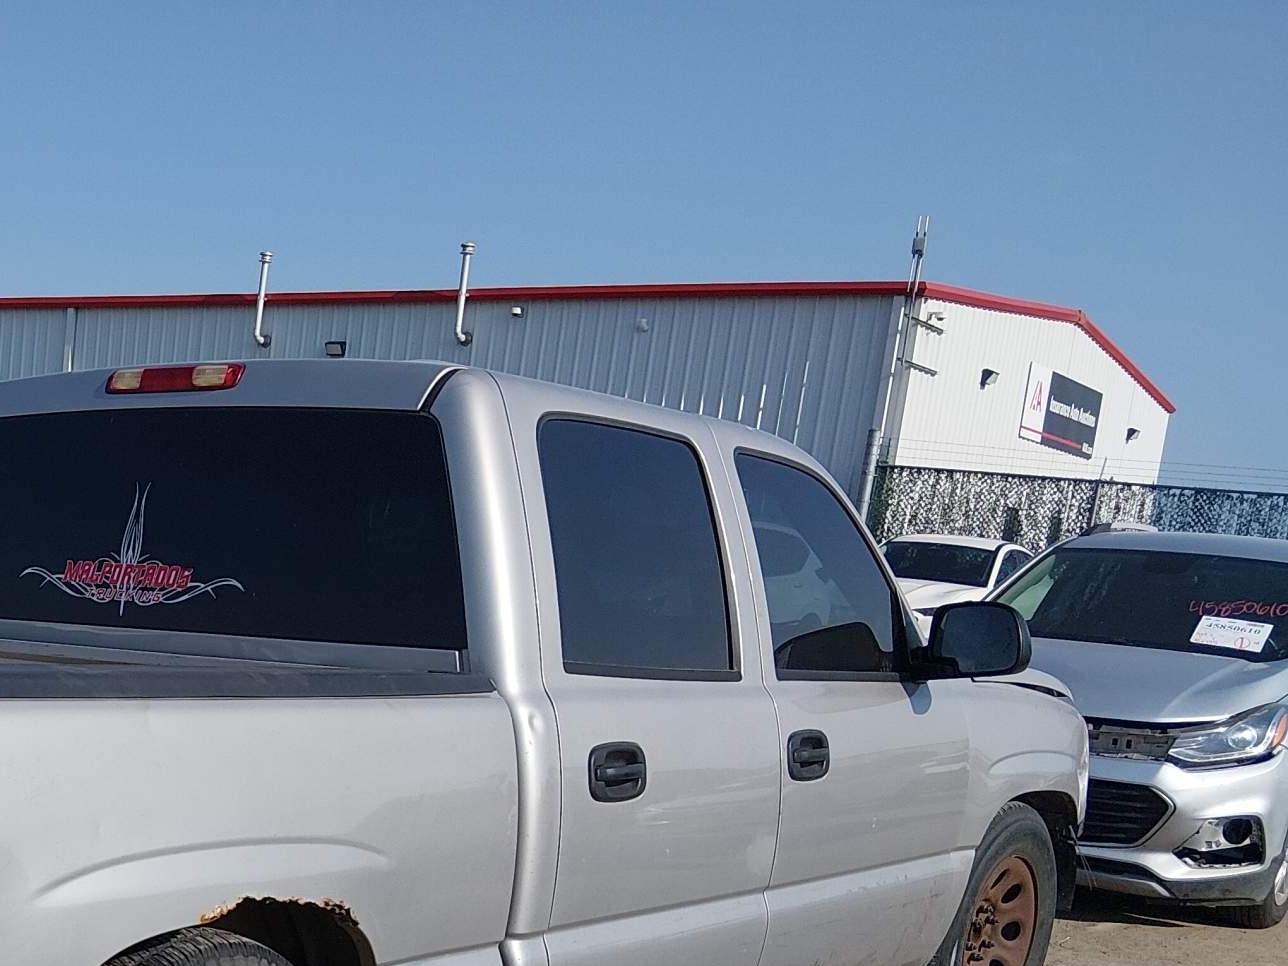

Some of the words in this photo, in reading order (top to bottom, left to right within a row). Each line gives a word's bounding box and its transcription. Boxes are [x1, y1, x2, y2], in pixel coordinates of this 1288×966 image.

[62, 560, 193, 589] MALPORTADOS
[85, 587, 163, 603] TRUCKING
[1189, 600, 1288, 617] 45850610
[1206, 622, 1261, 635] 45850610
